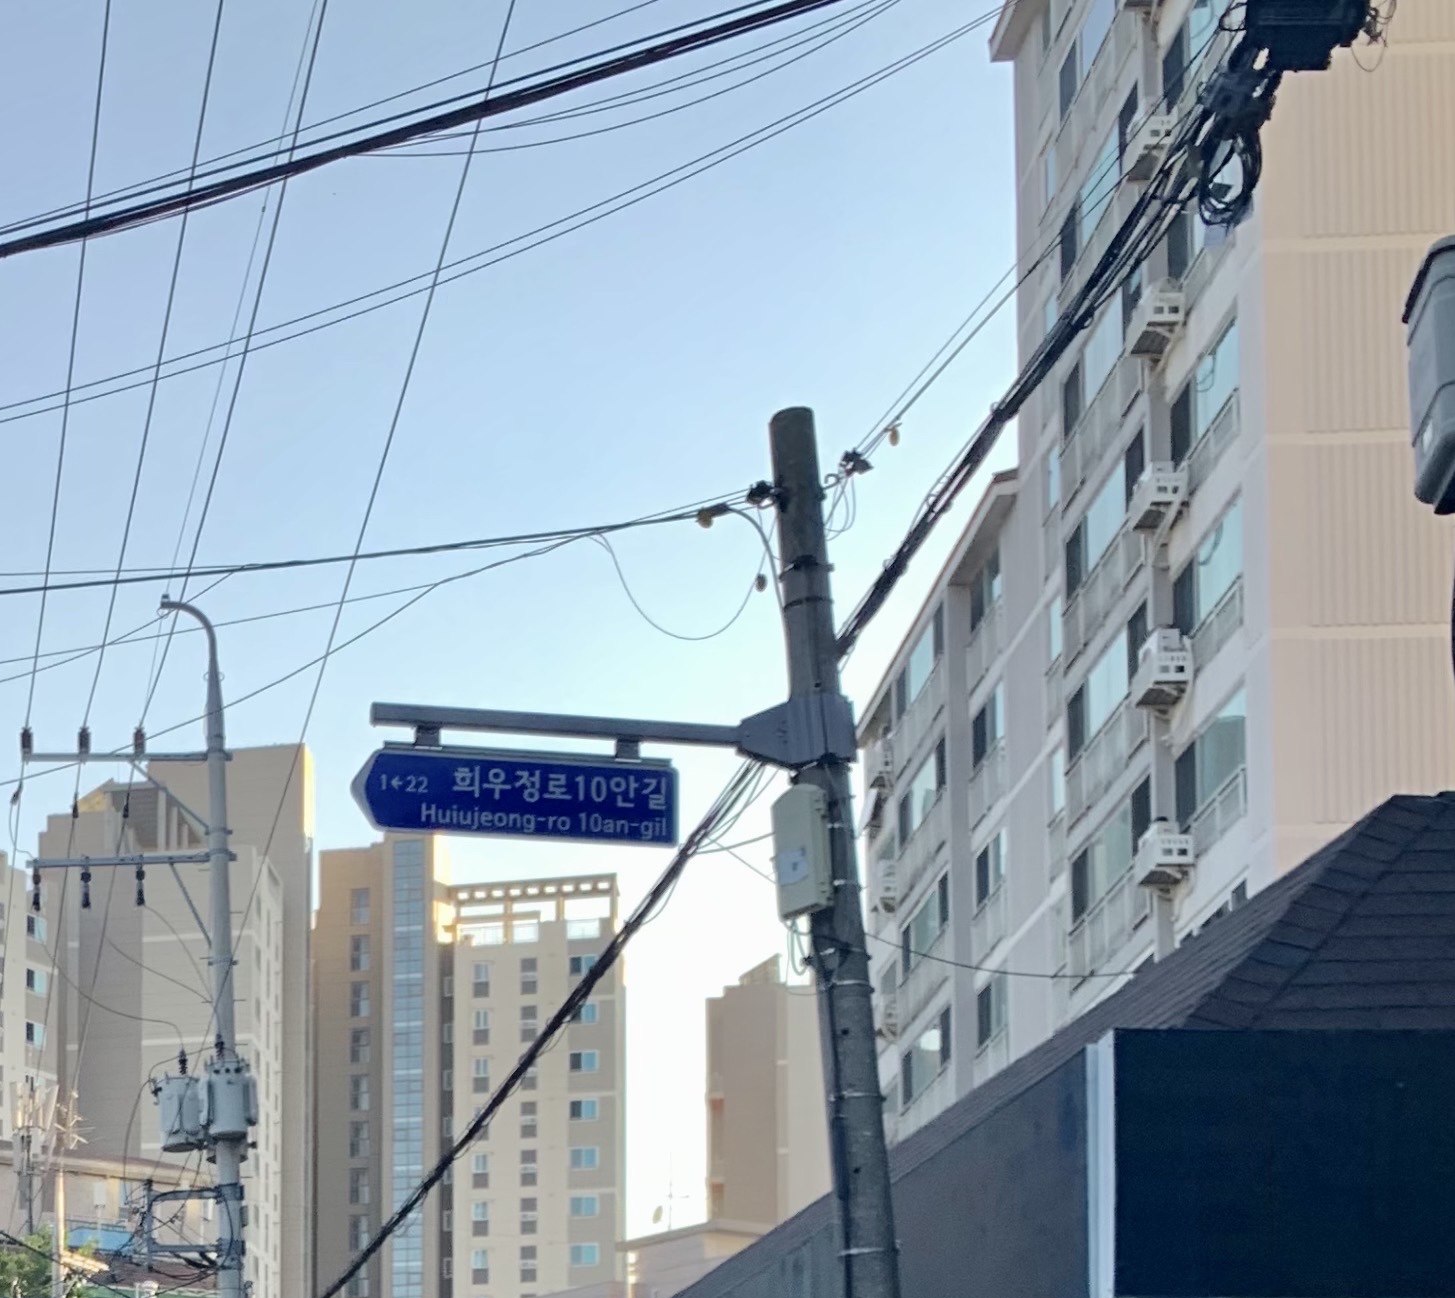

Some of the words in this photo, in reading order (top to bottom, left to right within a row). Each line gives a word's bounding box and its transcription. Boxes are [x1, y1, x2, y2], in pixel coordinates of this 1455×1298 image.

[452, 765, 666, 810] 희우정로10안길
[421, 803, 571, 833] Huiujeong-ro
[578, 812, 667, 840] 10an-gil
